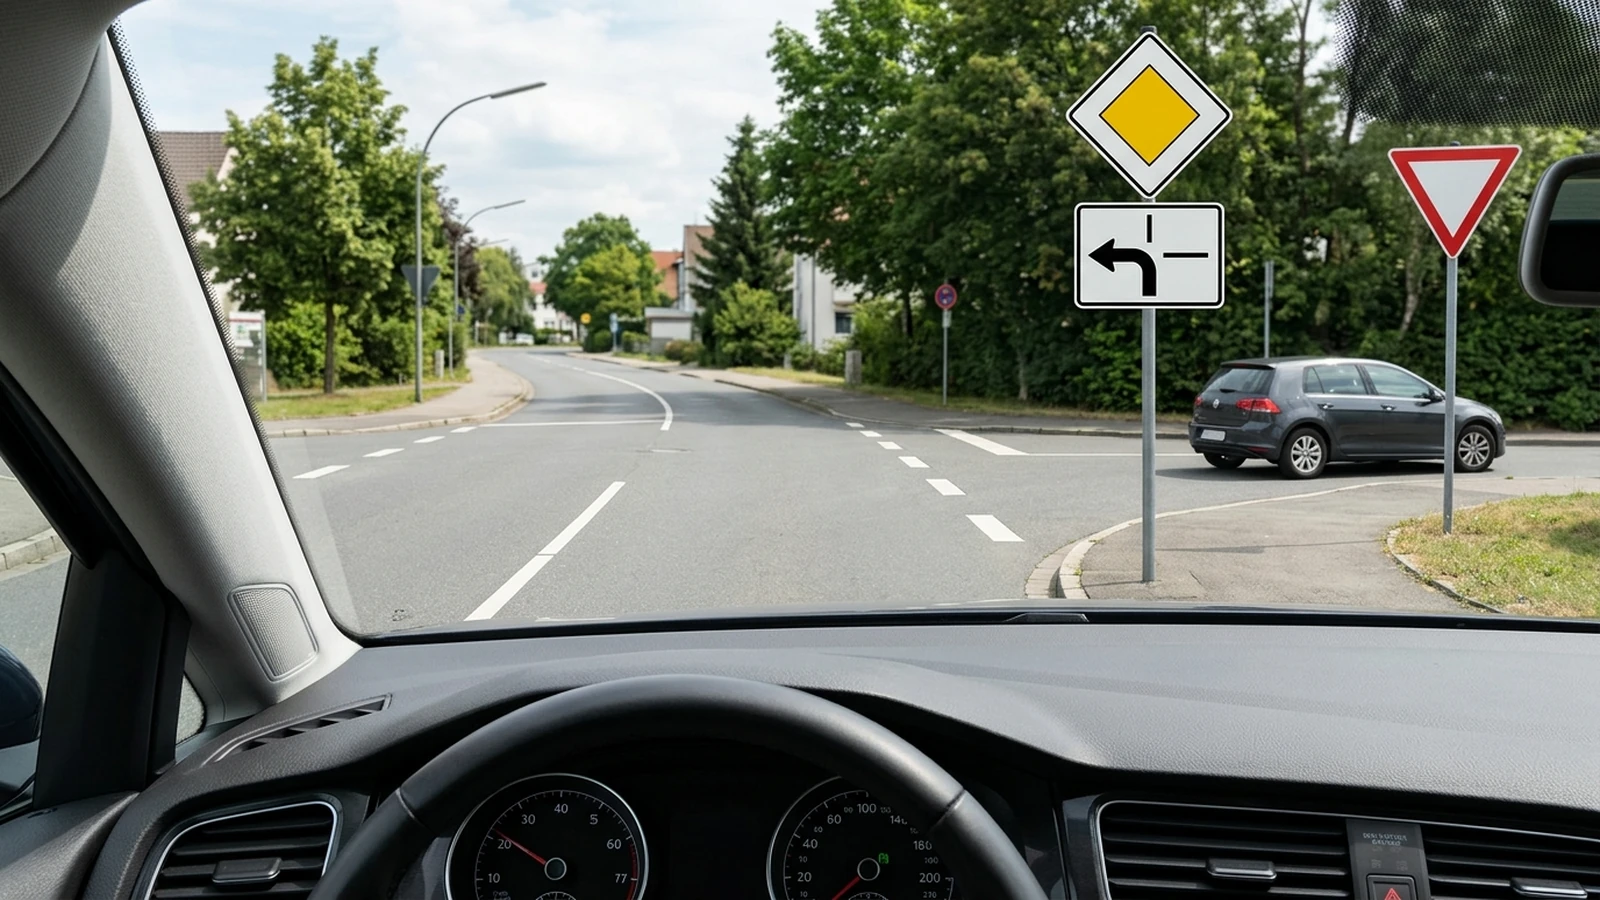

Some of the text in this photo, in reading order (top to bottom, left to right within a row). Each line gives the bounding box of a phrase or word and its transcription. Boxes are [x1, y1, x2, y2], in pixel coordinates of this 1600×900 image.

[554, 803, 569, 814] 40
[856, 802, 878, 814] 100
[521, 814, 536, 825] 30
[589, 814, 599, 825] 5
[826, 813, 842, 825] 60
[497, 838, 512, 850] 20
[606, 838, 622, 850] 60
[802, 838, 819, 850] 40
[488, 873, 501, 884] 10
[615, 873, 628, 884] 77
[797, 871, 813, 883] 20
[919, 872, 941, 884] 200
